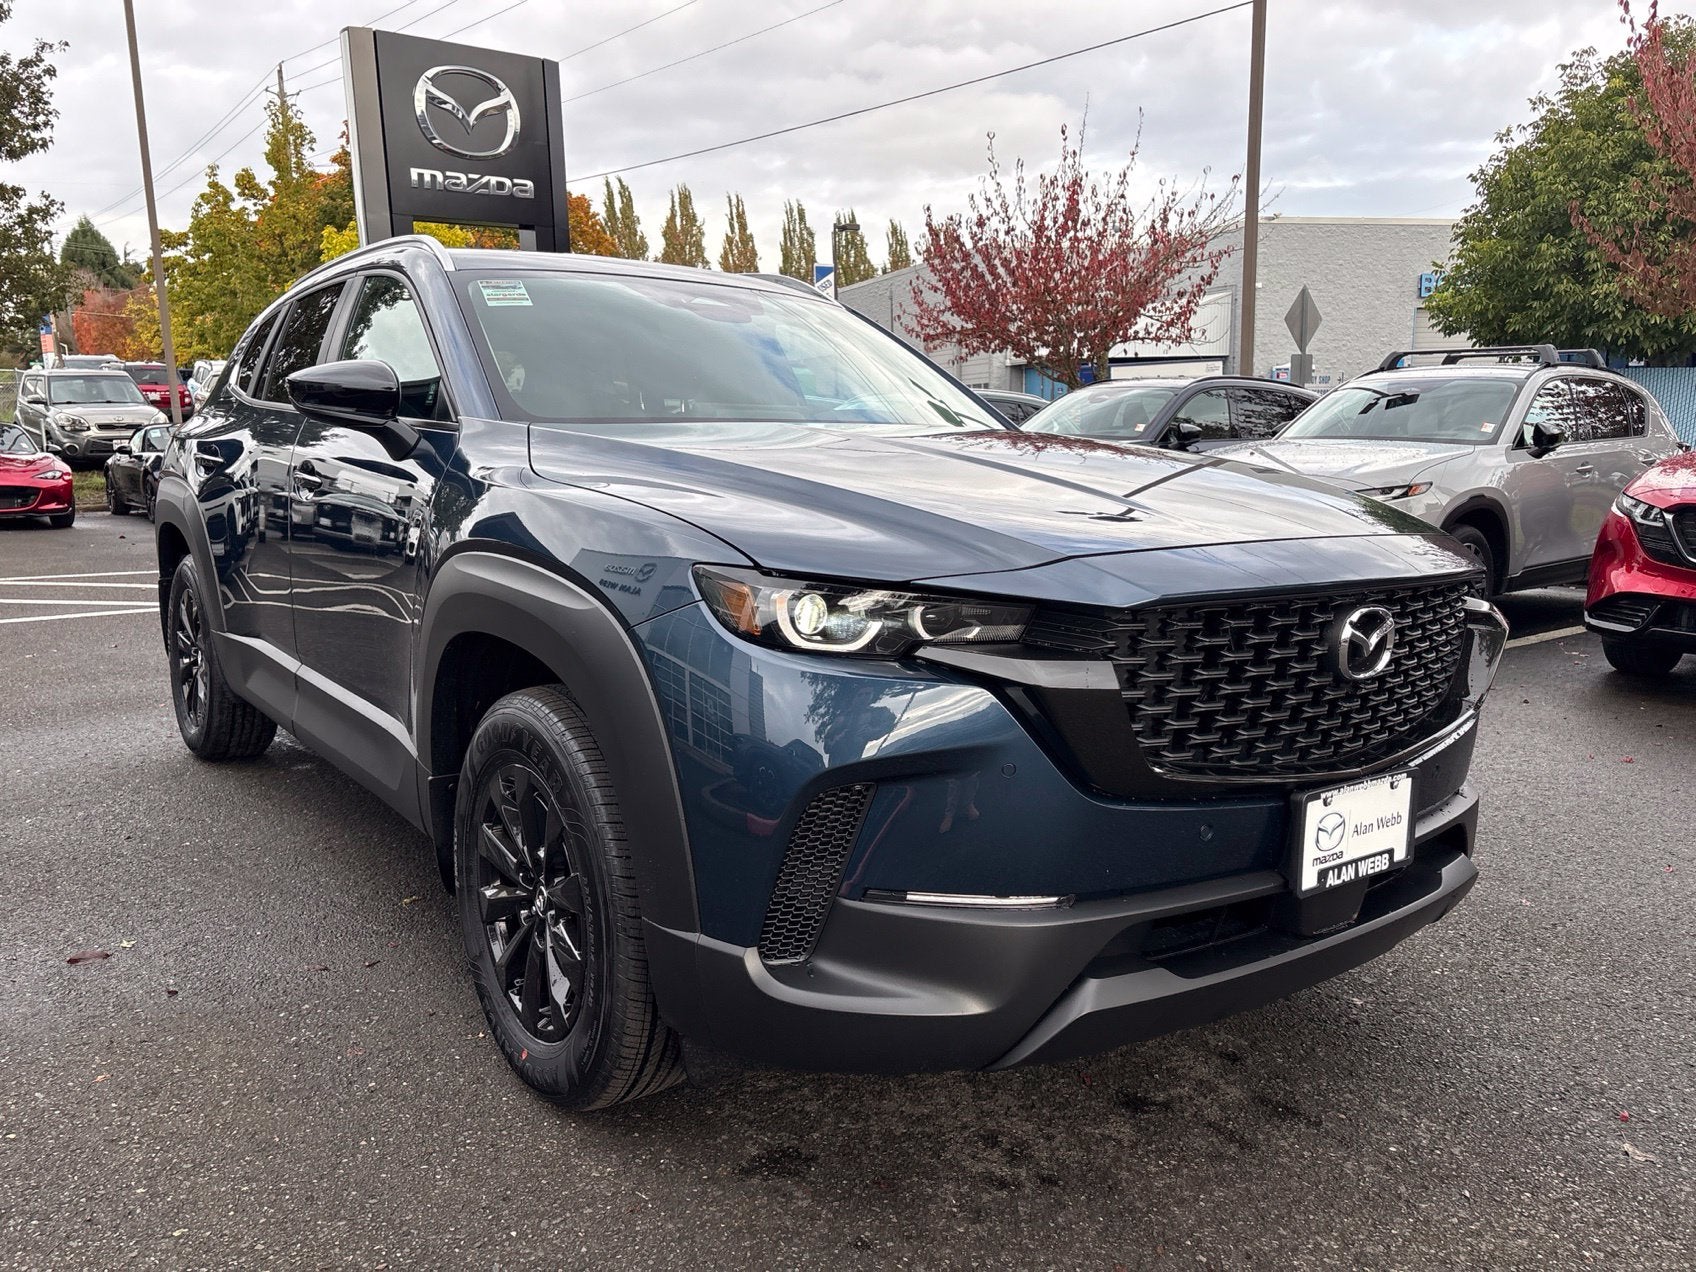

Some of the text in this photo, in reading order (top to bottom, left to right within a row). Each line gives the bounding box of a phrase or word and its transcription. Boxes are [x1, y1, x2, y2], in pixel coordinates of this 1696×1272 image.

[410, 167, 535, 199] mazda
[1319, 375, 1331, 385] SHOP
[1351, 811, 1403, 838] Alan Webb
[1312, 850, 1344, 867] mazda
[1325, 853, 1390, 888] ALAN WEBB
